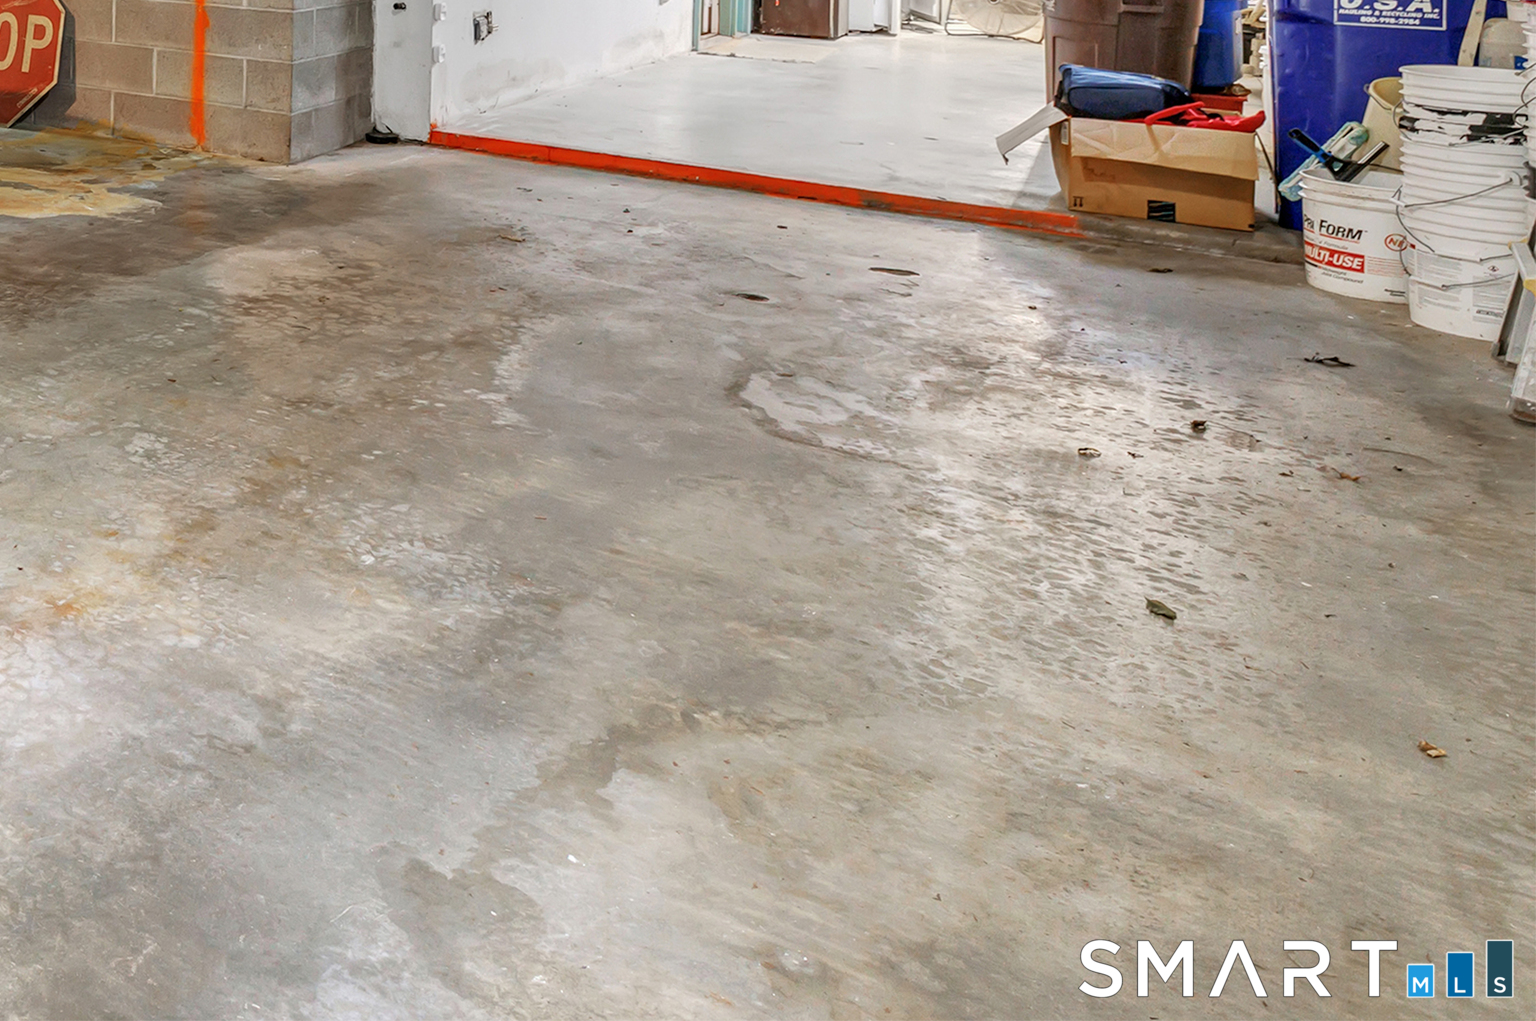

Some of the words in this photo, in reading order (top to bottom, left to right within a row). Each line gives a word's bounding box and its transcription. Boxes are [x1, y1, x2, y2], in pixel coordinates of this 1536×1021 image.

[1338, 8, 1373, 16] HAULING
[1381, 11, 1423, 19] RECYCLING
[1319, 219, 1363, 241] FORM
